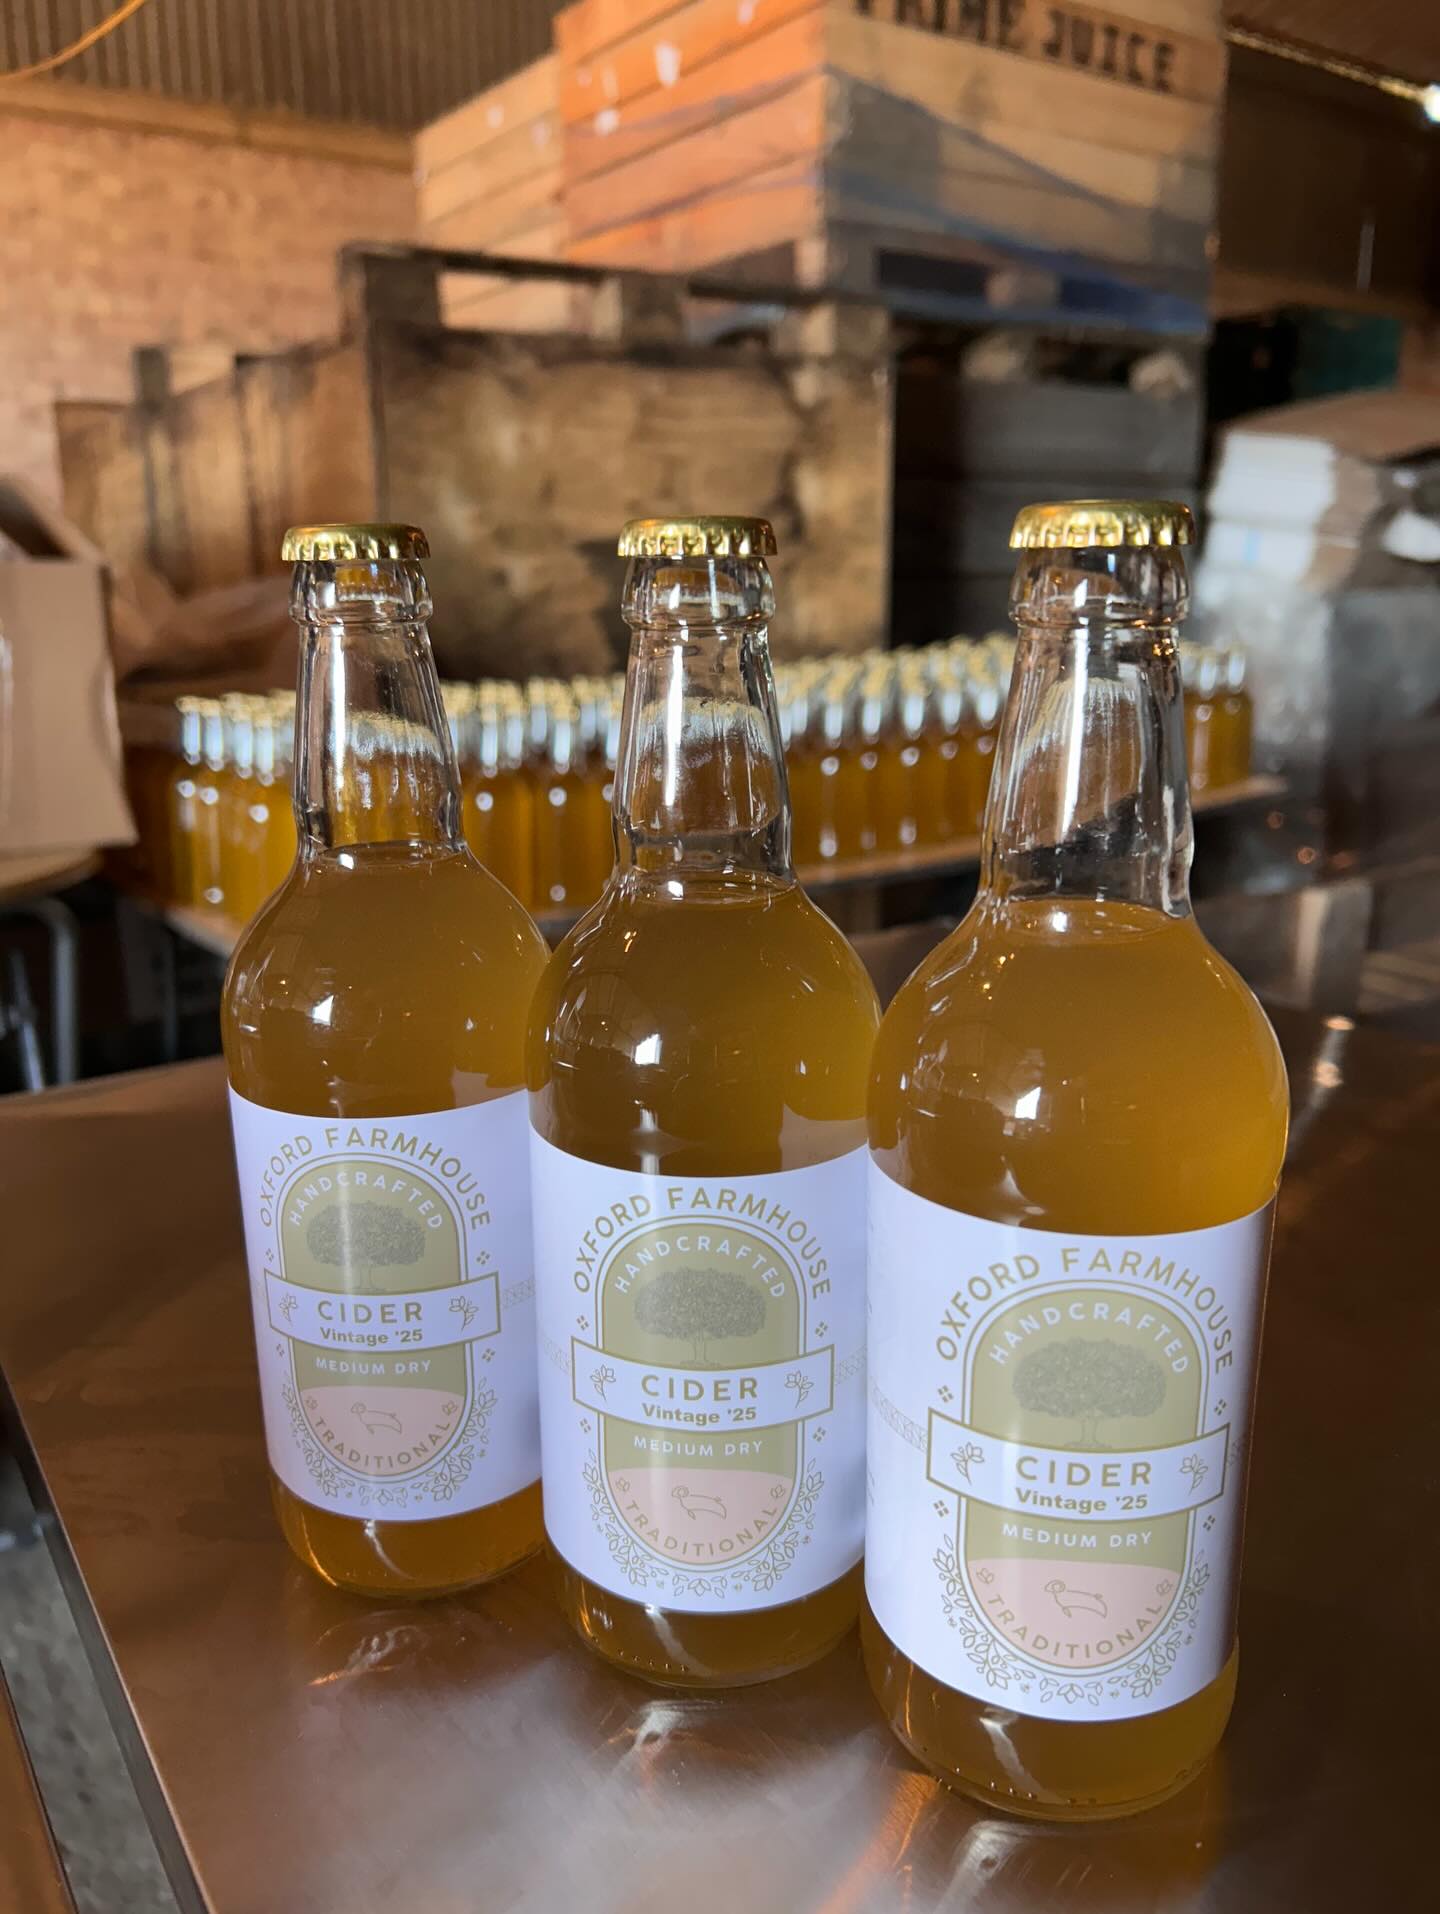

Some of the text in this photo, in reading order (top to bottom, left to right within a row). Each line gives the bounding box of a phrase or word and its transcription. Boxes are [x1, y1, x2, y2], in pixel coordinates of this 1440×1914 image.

[1042, 9, 1175, 93] JUICE
[260, 1128, 490, 1229] OXFORD FARMHOUSE
[289, 1172, 442, 1228] HANDCRAFTED
[573, 1187, 832, 1299] OXFORD FARMHOUSE
[614, 1236, 785, 1297] HANDCRAFTED
[317, 1300, 423, 1324] CIDER
[321, 1327, 423, 1345] Vintage '25
[935, 1247, 1233, 1375] OXFORD FARMHOUSE
[989, 1302, 1189, 1374] HANDCRAFTED
[316, 1357, 431, 1375] MEDIUM DRY
[641, 1375, 757, 1401] CIDER
[643, 1403, 756, 1426] Vintage '25
[314, 1417, 451, 1469] TRADITIONAL
[634, 1435, 763, 1456] MEDIUM DRY
[1016, 1456, 1152, 1487] CIDER
[1016, 1487, 1148, 1515] Vintage '25
[625, 1503, 777, 1556] TRADITIONAL
[1002, 1523, 1152, 1548] MEDIUM DRY
[988, 1595, 1163, 1659] TRADITIONAL
